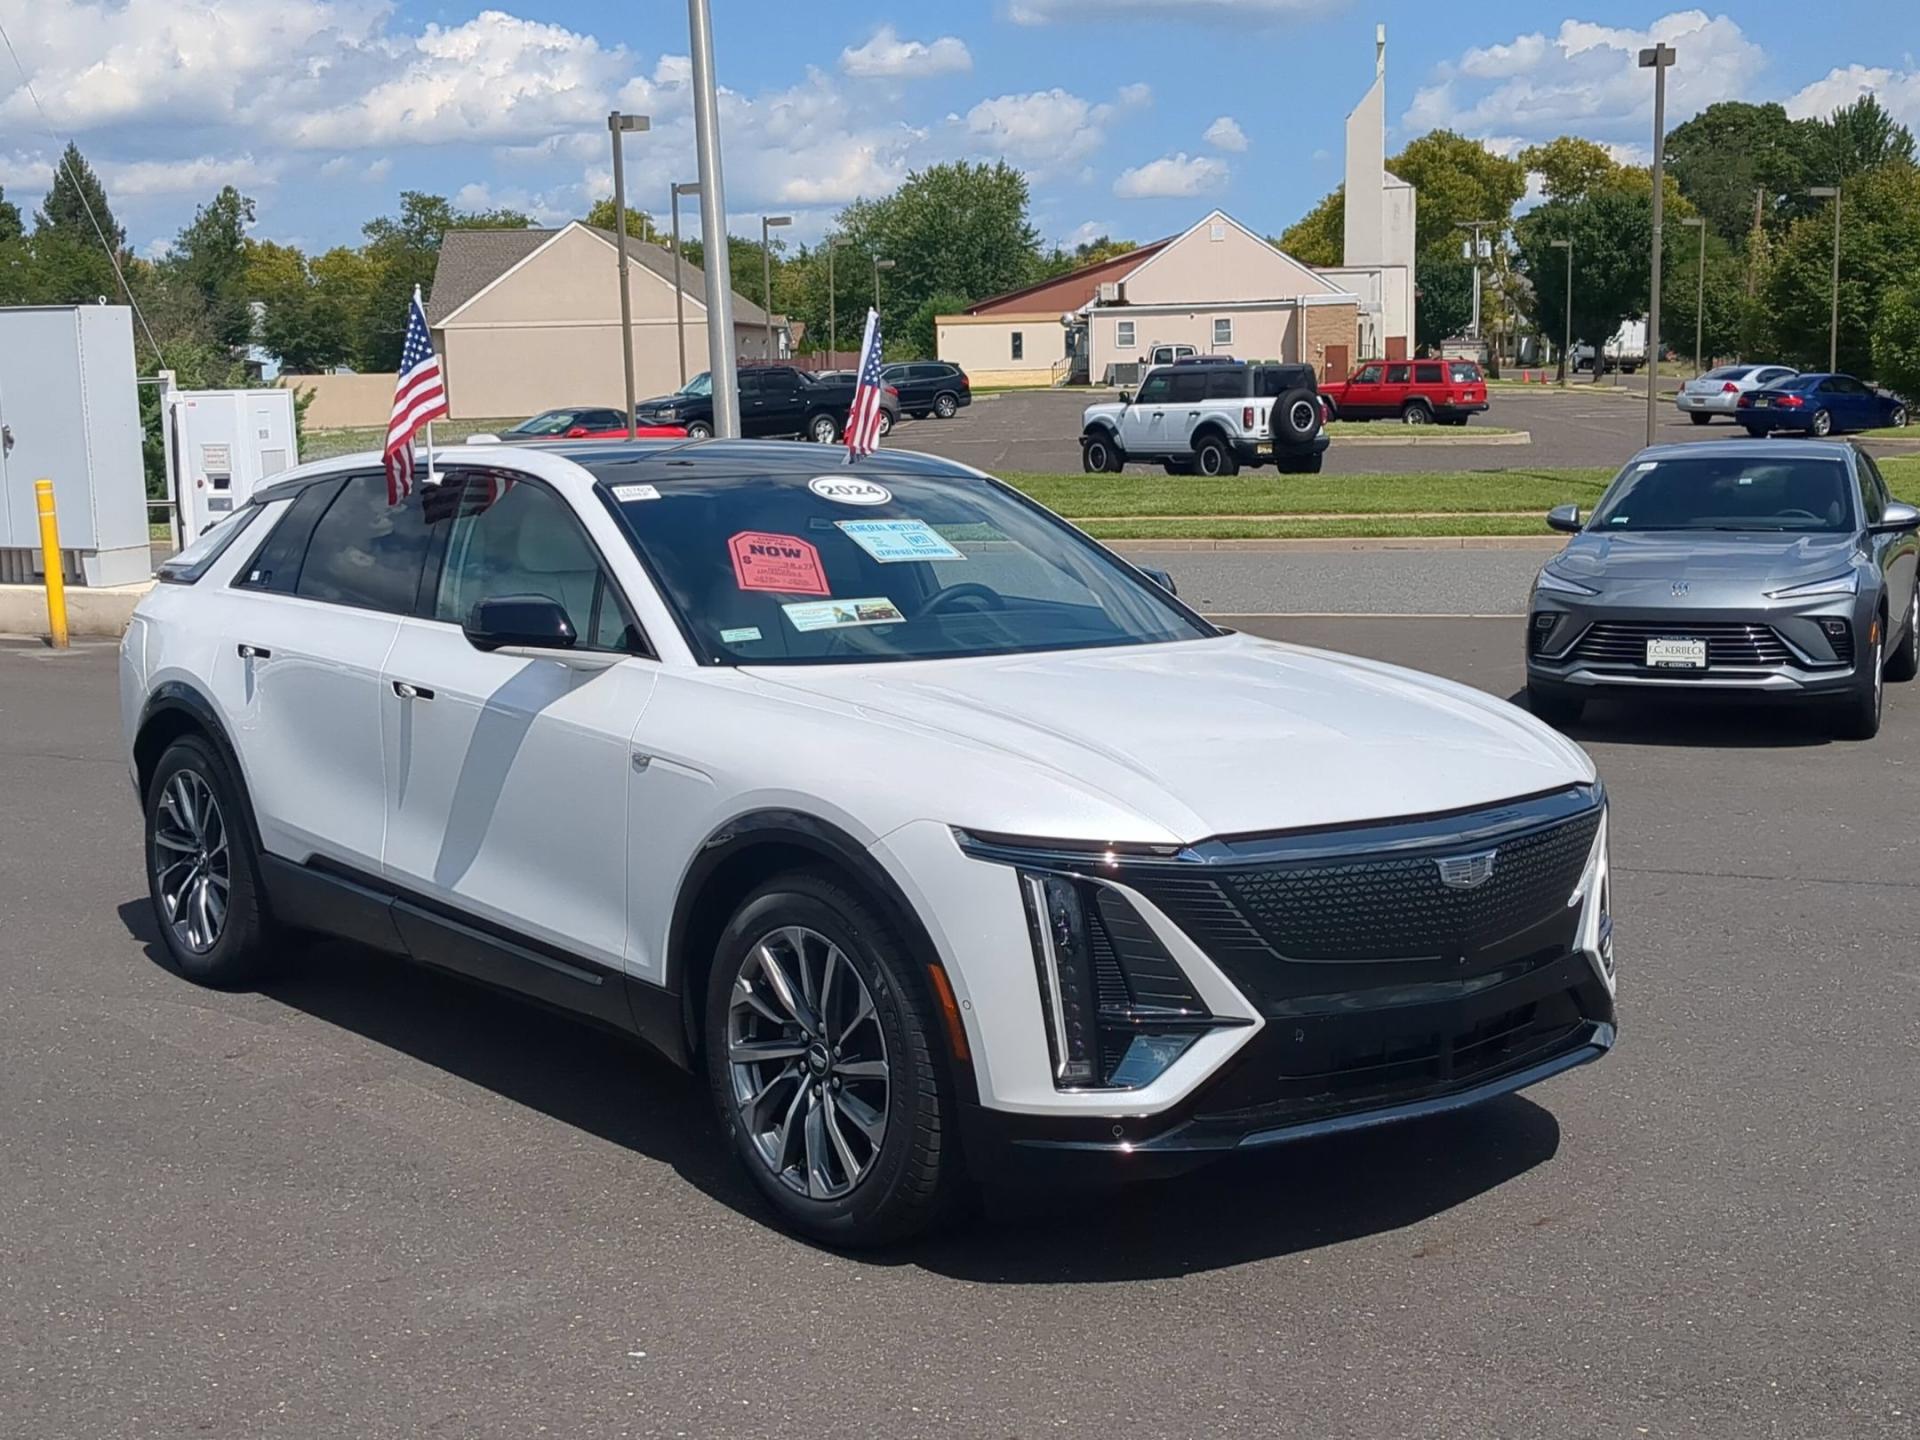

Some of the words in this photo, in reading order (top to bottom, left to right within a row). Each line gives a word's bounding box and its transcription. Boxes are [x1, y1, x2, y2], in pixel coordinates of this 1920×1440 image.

[819, 484, 881, 496] 2024
[844, 523, 887, 533] GENERAL
[888, 522, 929, 532] MOTORS
[749, 544, 802, 559] NOW
[1665, 646, 1704, 655] KERBECK
